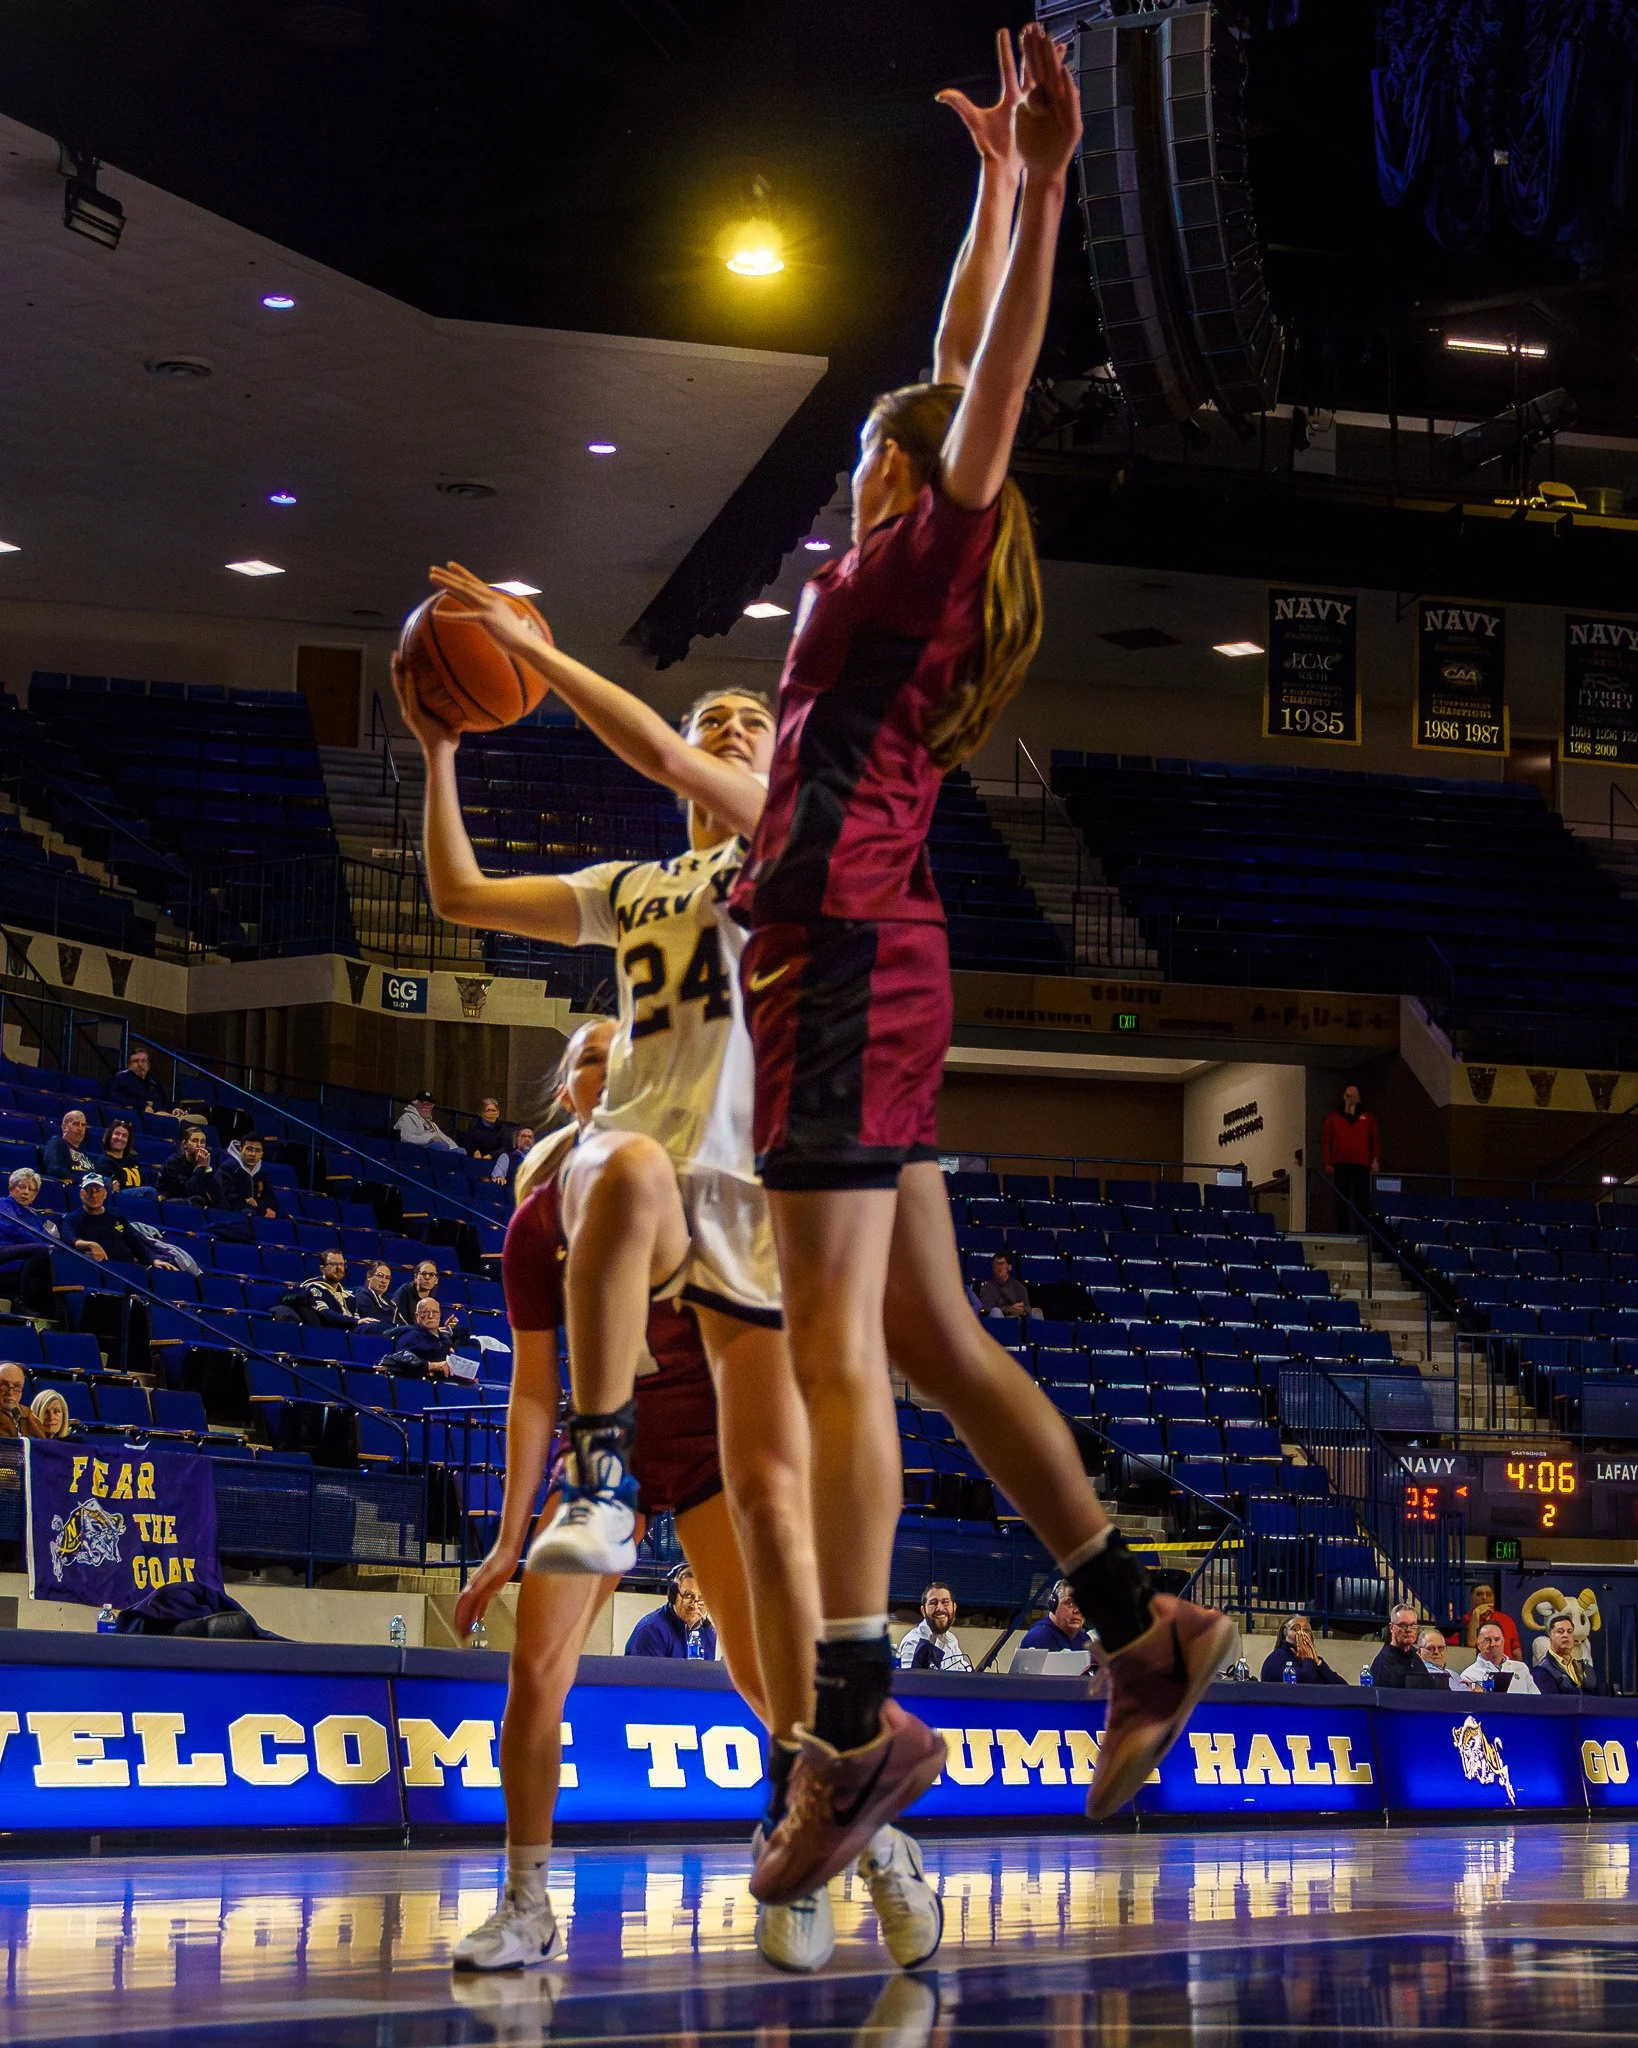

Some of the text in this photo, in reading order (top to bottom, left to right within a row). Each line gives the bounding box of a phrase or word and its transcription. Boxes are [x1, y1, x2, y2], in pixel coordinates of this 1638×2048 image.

[1274, 597, 1352, 626] NAVY
[1424, 609, 1501, 637] NAVY
[1569, 623, 1638, 652] NAVY
[1280, 708, 1344, 734] 1985
[1424, 720, 1500, 744] 1986 1987
[1569, 742, 1618, 757] 1998 2000
[618, 867, 740, 934] NAVY
[388, 978, 418, 1001] GG
[624, 927, 732, 1039] 24
[1119, 1015, 1137, 1029] EXIT
[121, 1166, 142, 1187] N
[69, 1456, 156, 1500] FEAR
[1400, 1456, 1456, 1474] NAVY
[1507, 1461, 1575, 1493] 4:06
[1597, 1463, 1638, 1481] LAFAY
[132, 1513, 178, 1544] THE
[1542, 1504, 1556, 1527] 2
[1496, 1541, 1517, 1559] EXIT
[132, 1555, 196, 1590] GOAT
[0, 1711, 579, 1788] ELCOM
[626, 1723, 764, 1788] TO
[1189, 1732, 1373, 1785] HALL
[1581, 1739, 1630, 1784] GO
